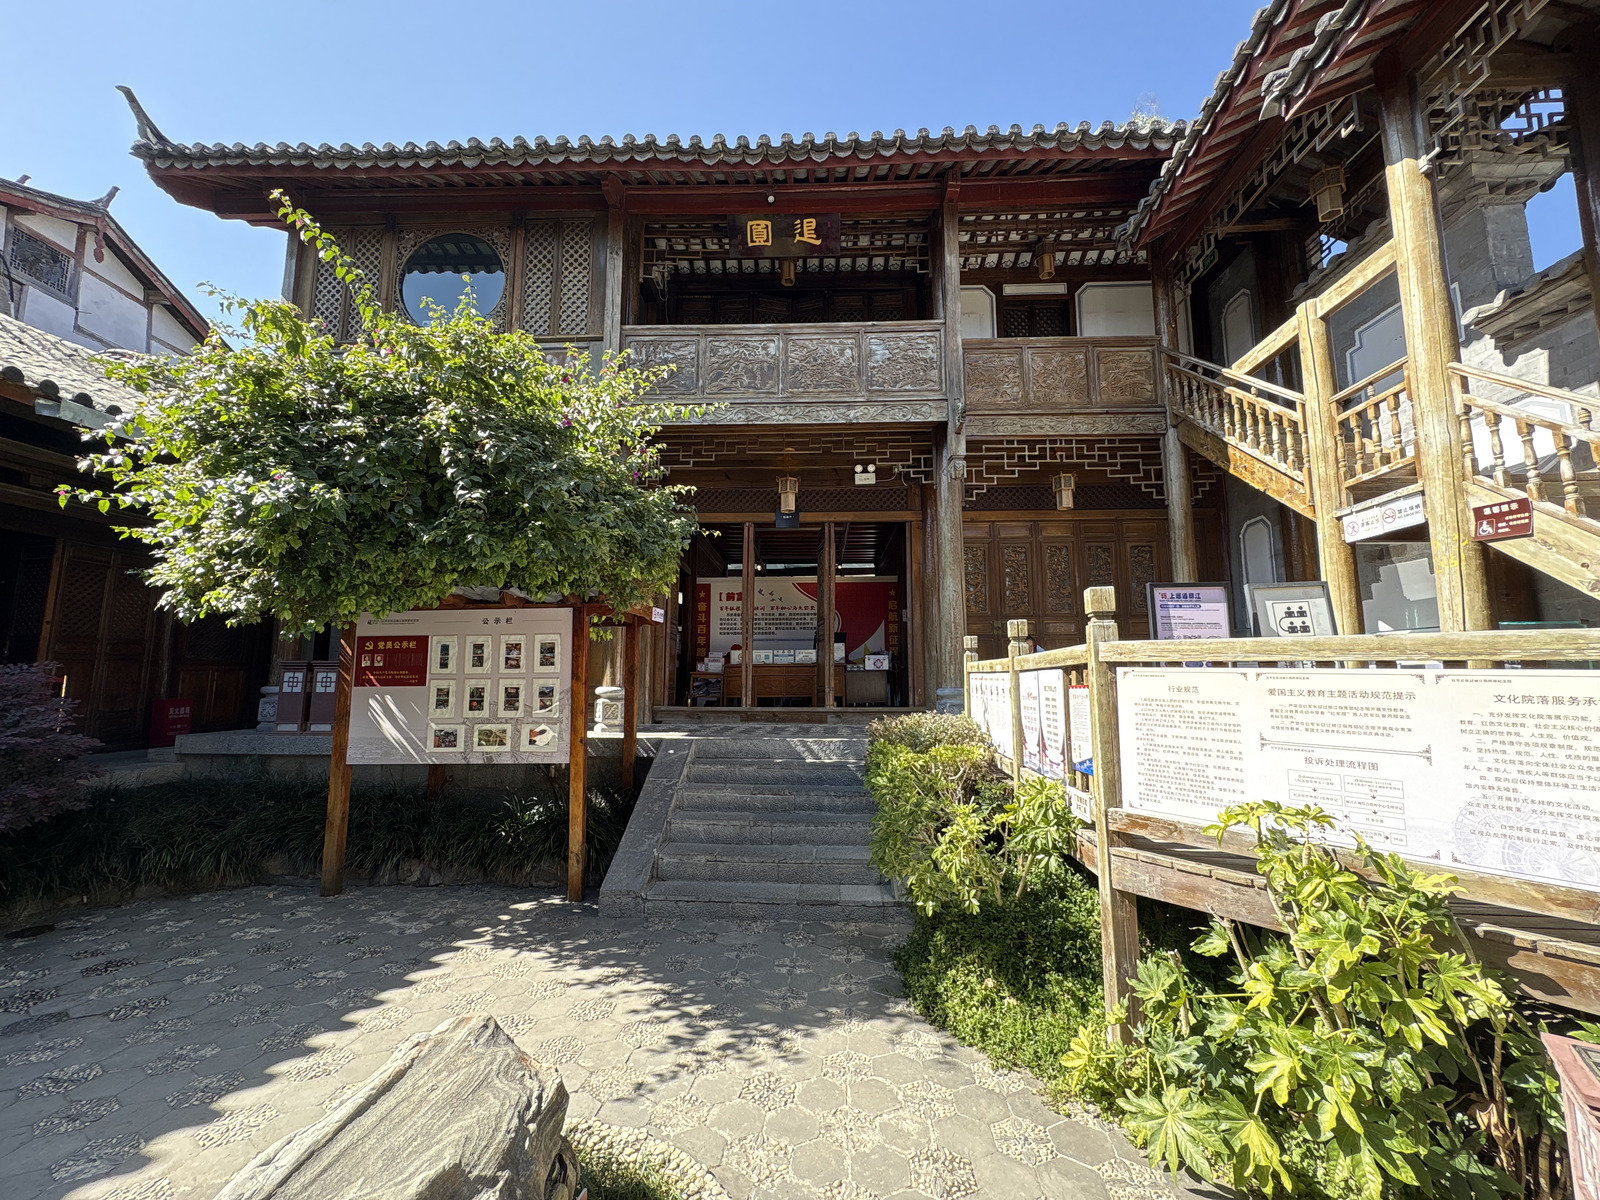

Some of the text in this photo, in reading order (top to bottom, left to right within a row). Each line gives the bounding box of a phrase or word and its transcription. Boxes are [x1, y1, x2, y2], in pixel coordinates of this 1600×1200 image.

[482, 616, 514, 625] 公示栏
[696, 601, 707, 657] 奋斗百年路
[377, 640, 417, 649] 党员公示栏
[1168, 685, 1200, 694] 行业规范
[1267, 688, 1417, 701] 爱国主义教育主题活动规范提示
[1492, 694, 1600, 707] 文化院落服务承
[1304, 756, 1379, 772] 投诉处理流程图
[1479, 775, 1600, 792] 四、院内应保持整体环境卫生洁
